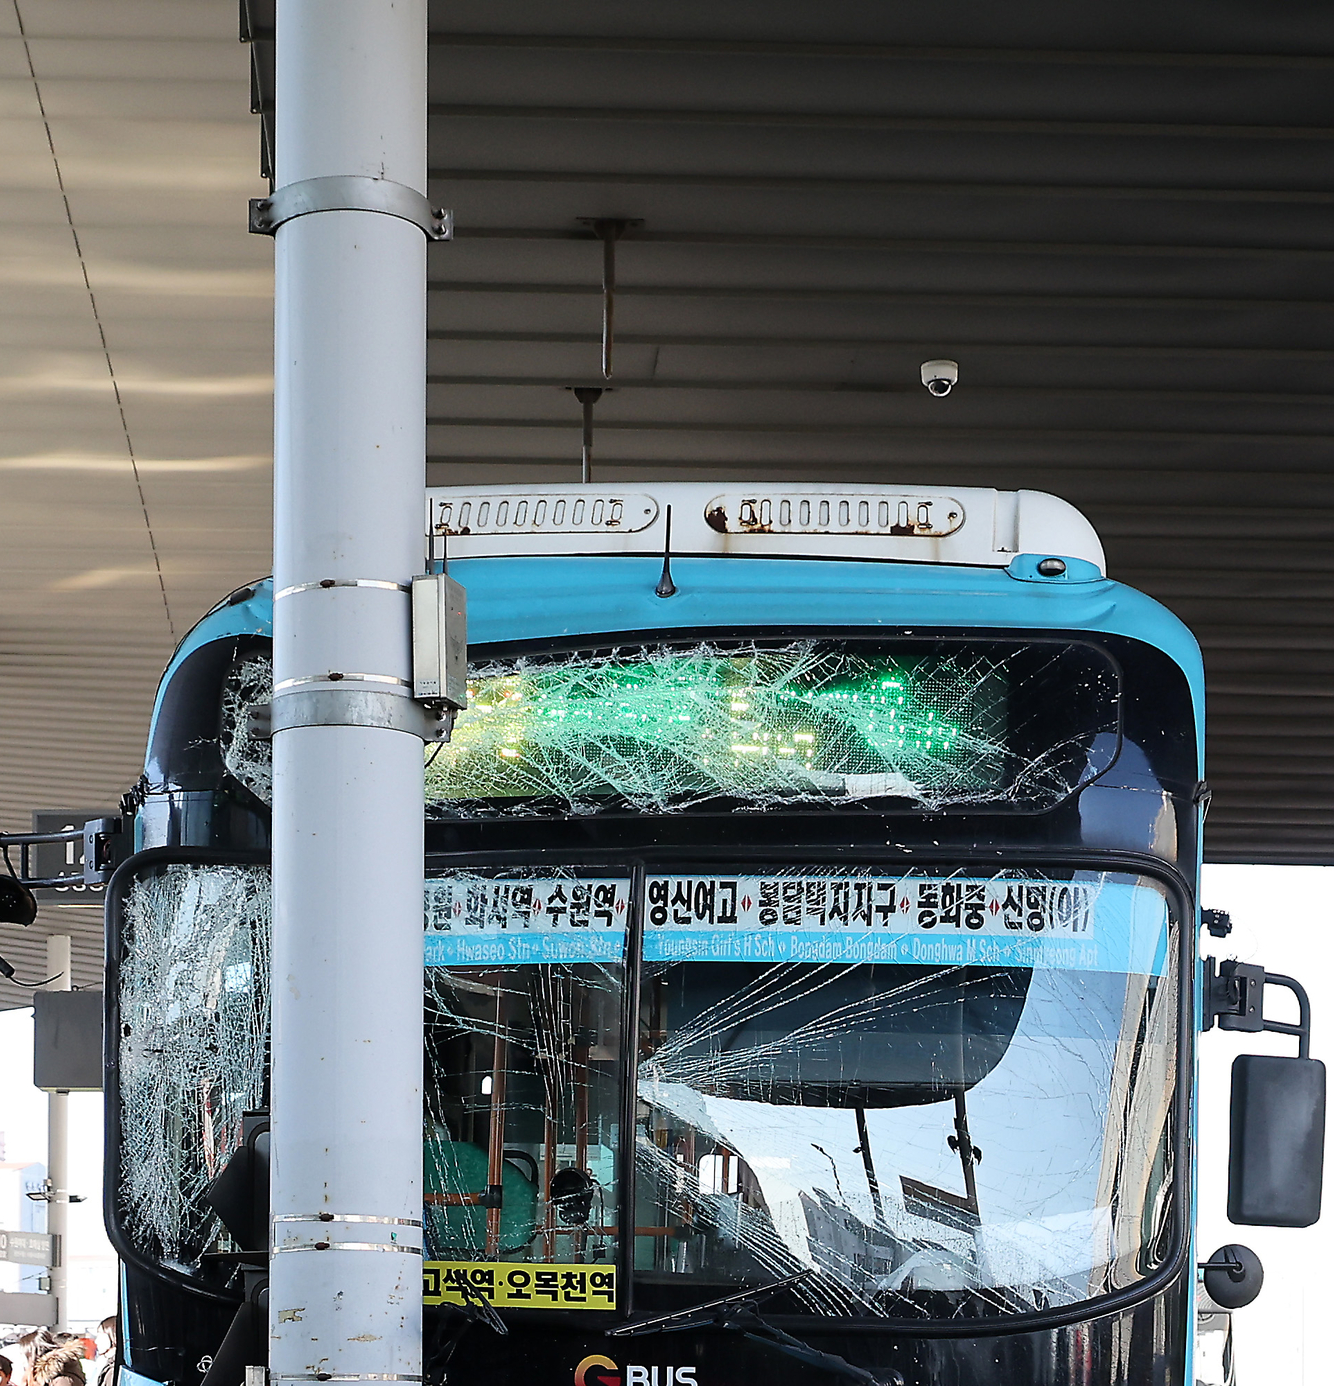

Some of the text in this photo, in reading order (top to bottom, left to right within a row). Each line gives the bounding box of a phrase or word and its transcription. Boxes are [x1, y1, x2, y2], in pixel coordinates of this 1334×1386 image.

[546, 883, 617, 928] 수원역
[648, 880, 737, 926] 영신여고
[758, 880, 896, 928] 봉담택지지구
[916, 882, 986, 930] 동화중
[424, 939, 446, 962] ark
[457, 937, 505, 962] Hwaseo
[508, 937, 530, 961] Stn
[754, 935, 775, 957] Sch
[790, 936, 842, 961] Bongdam
[845, 936, 897, 962] Bongdam
[913, 938, 963, 962] Donghwa
[966, 939, 977, 960] M
[979, 938, 1000, 962] Sch
[1078, 942, 1099, 966] Apt
